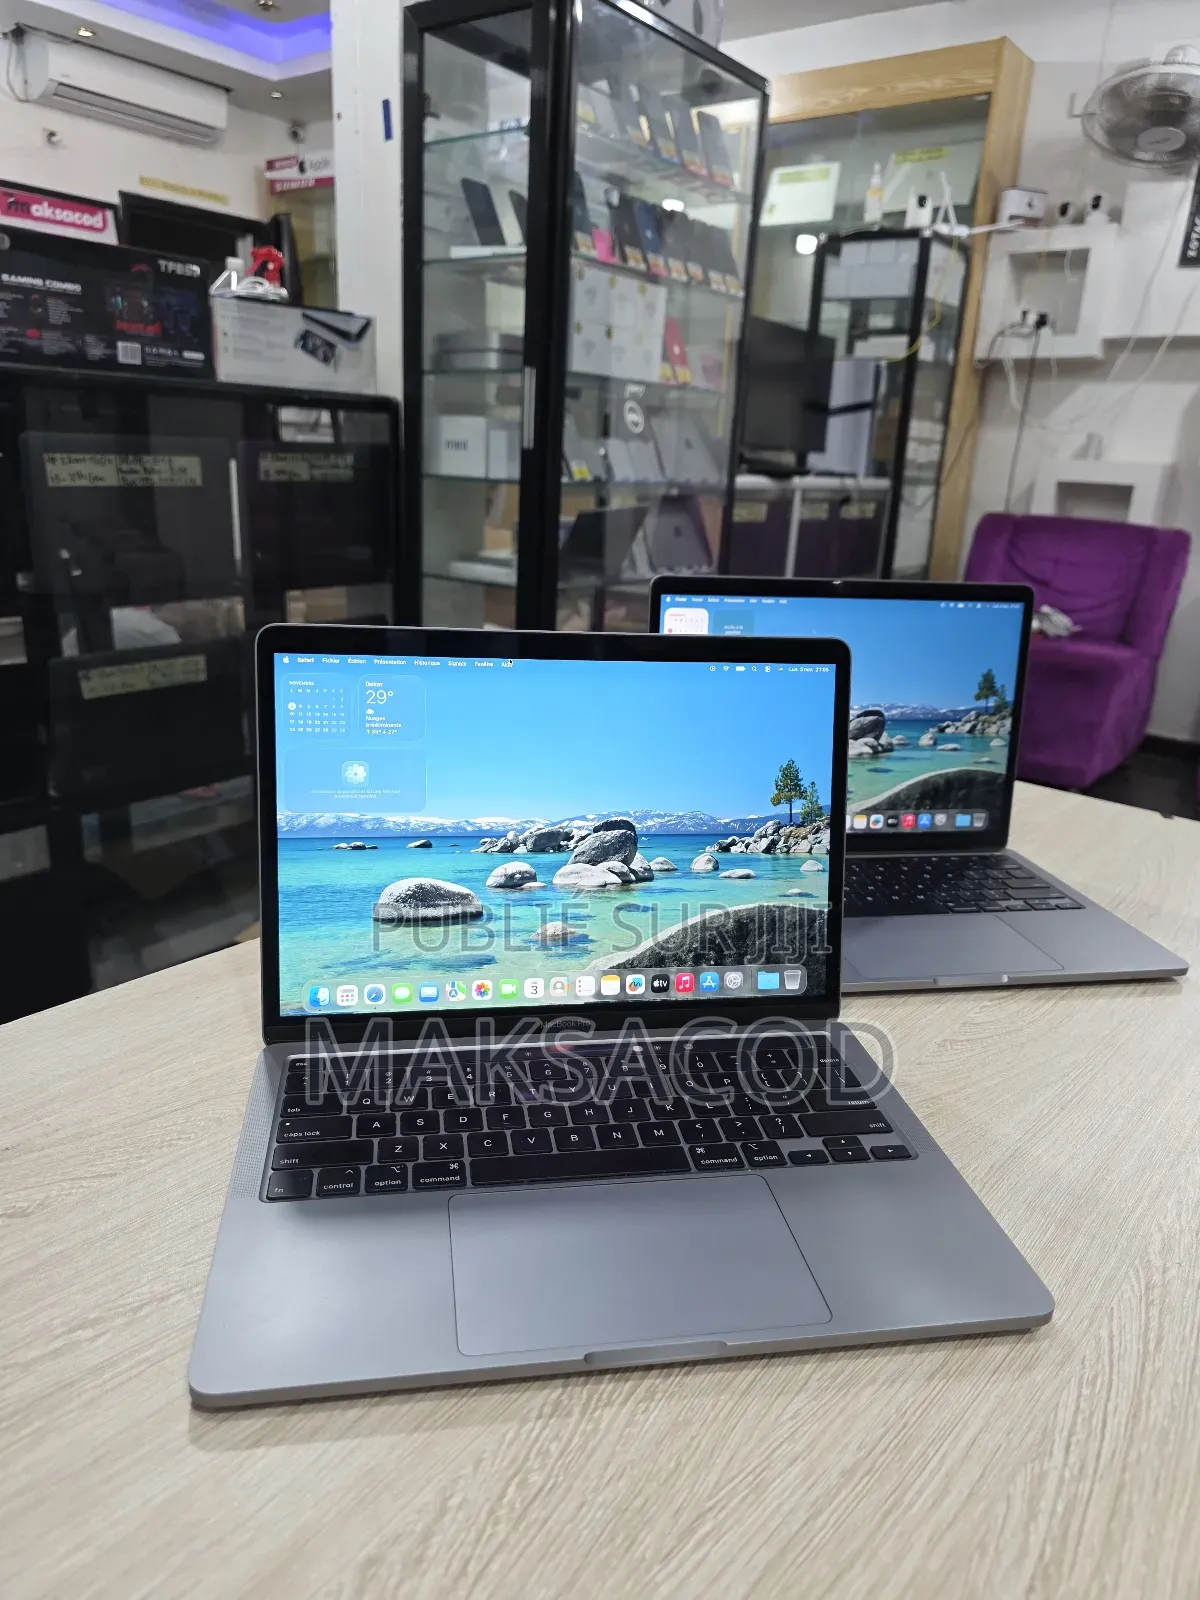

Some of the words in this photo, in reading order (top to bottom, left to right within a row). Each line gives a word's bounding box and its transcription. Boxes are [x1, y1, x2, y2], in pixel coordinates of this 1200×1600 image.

[365, 689, 394, 704] 29°
[530, 985, 538, 995] 3
[540, 1020, 576, 1028] MacBook
[584, 1108, 594, 1116] H
[483, 1139, 492, 1147] C
[527, 1136, 536, 1144] V
[612, 1131, 622, 1139] N
[374, 1179, 402, 1187] option
[420, 1175, 460, 1183] command
[700, 1156, 738, 1165] command
